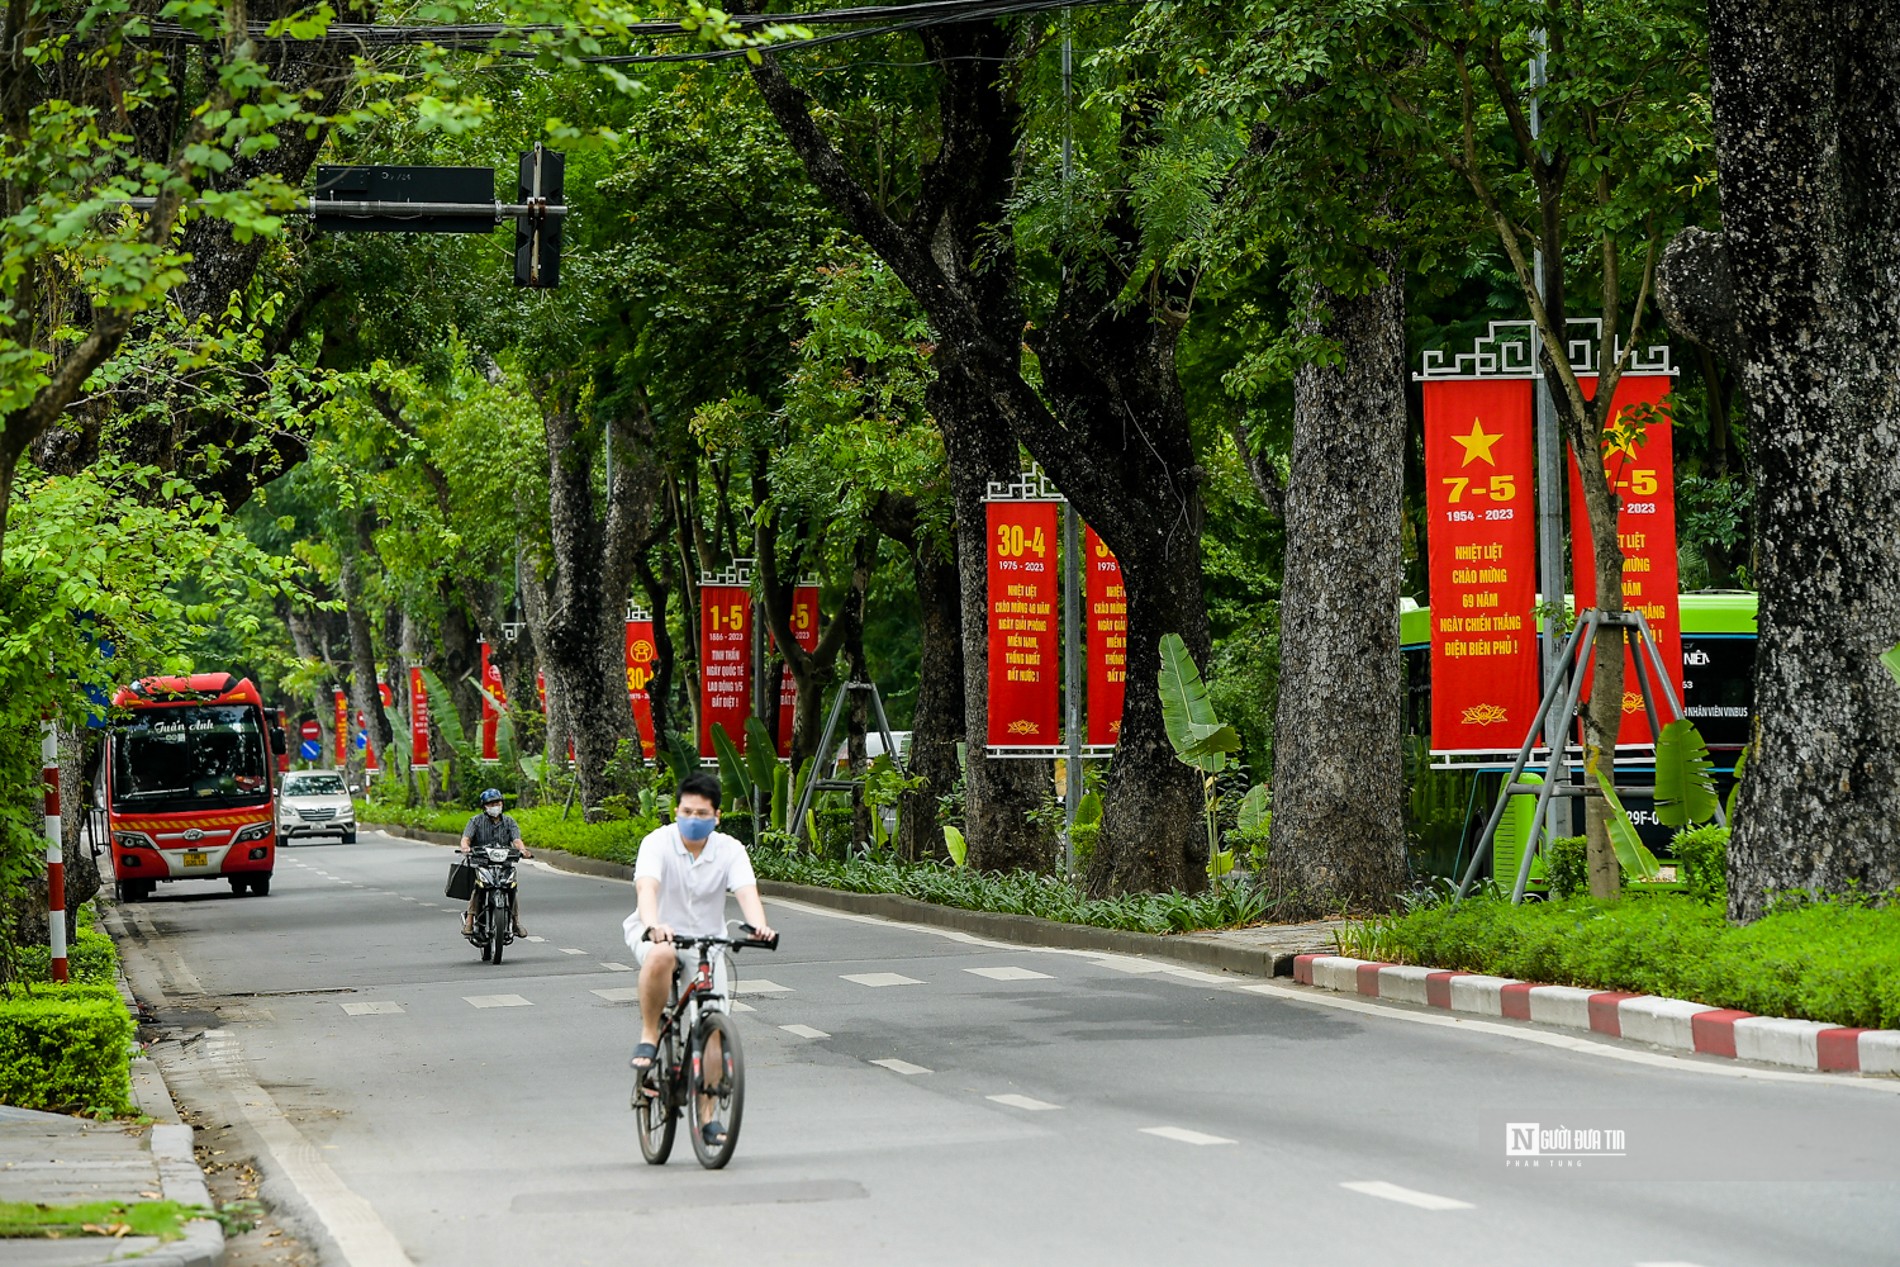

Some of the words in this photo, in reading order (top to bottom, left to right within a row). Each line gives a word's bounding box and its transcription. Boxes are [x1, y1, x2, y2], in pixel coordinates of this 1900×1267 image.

[1442, 475, 1516, 504] 7-5
[1446, 511, 1475, 522] 1954
[1485, 508, 1514, 520] 2023
[1627, 503, 1655, 514] 2023
[998, 524, 1045, 558] 30-4
[1627, 532, 1645, 551] LIỆT
[1455, 543, 1482, 563] NHIỆT
[1484, 542, 1503, 562] LIỆT
[999, 561, 1018, 570] 1975
[1025, 562, 1044, 572] 2023
[1097, 562, 1116, 571] 1975
[1452, 567, 1478, 584] CHÀO
[1480, 566, 1507, 584] MỪNG
[1008, 583, 1024, 598] NHIỆT
[1025, 584, 1037, 600] LIỆT
[1462, 594, 1473, 608] 69
[1476, 591, 1498, 607] NĂM
[995, 601, 1010, 613] CHÀO
[710, 605, 743, 631] 1-5
[1440, 615, 1463, 632] NGÀY
[1465, 613, 1491, 632] CHIẾN
[1493, 612, 1521, 630] THẮNG
[1445, 640, 1467, 659] ĐIỆN
[1469, 639, 1490, 655] BIÊN
[1493, 635, 1512, 655] PHỦ
[1688, 705, 1707, 717] NHÂN
[1707, 705, 1723, 717] VIÊN
[1724, 707, 1748, 717] VINBUS
